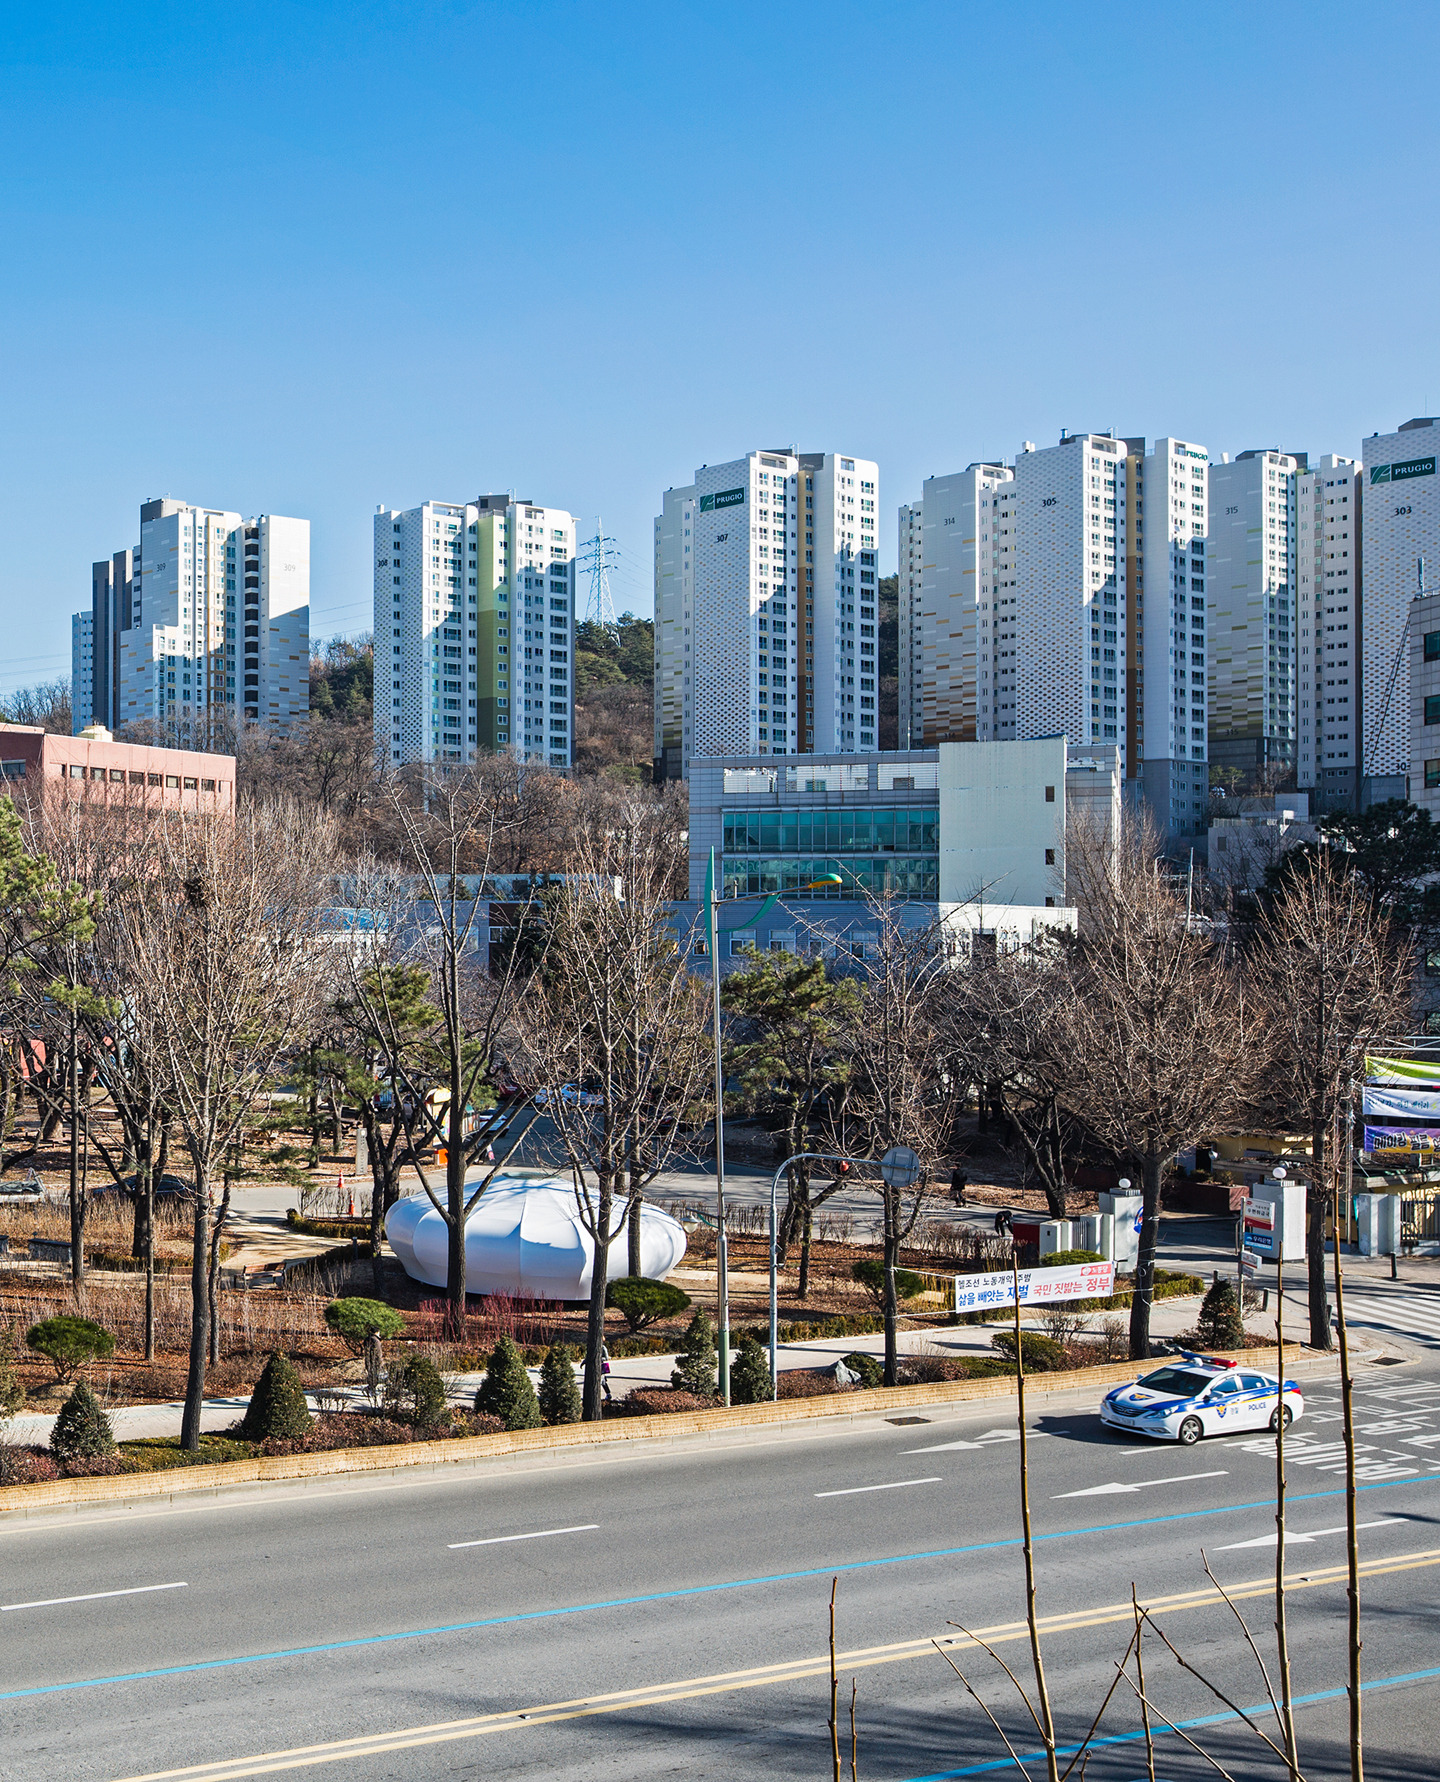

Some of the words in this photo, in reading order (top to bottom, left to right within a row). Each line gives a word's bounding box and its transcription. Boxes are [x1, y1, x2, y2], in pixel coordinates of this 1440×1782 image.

[1394, 462, 1433, 475] PRUGIO
[716, 492, 743, 505] PRUGIO
[1041, 497, 1057, 508] 305
[1225, 505, 1239, 515] 315
[1394, 505, 1413, 517] 303
[943, 517, 956, 526] 314
[716, 533, 729, 543] 307
[156, 563, 166, 572] 309
[283, 564, 296, 572] 309
[1373, 1131, 1408, 1150] 메이킹
[1410, 1134, 1430, 1151] 필름
[957, 1277, 980, 1290] 헬조선
[958, 1291, 976, 1307] 삶을
[977, 1288, 1005, 1304] 빼앗는
[1033, 1283, 1052, 1296] 국민
[1054, 1281, 1083, 1295] 짓밟는
[1086, 1277, 1110, 1292] 정부
[1248, 1401, 1266, 1411] POLICE
